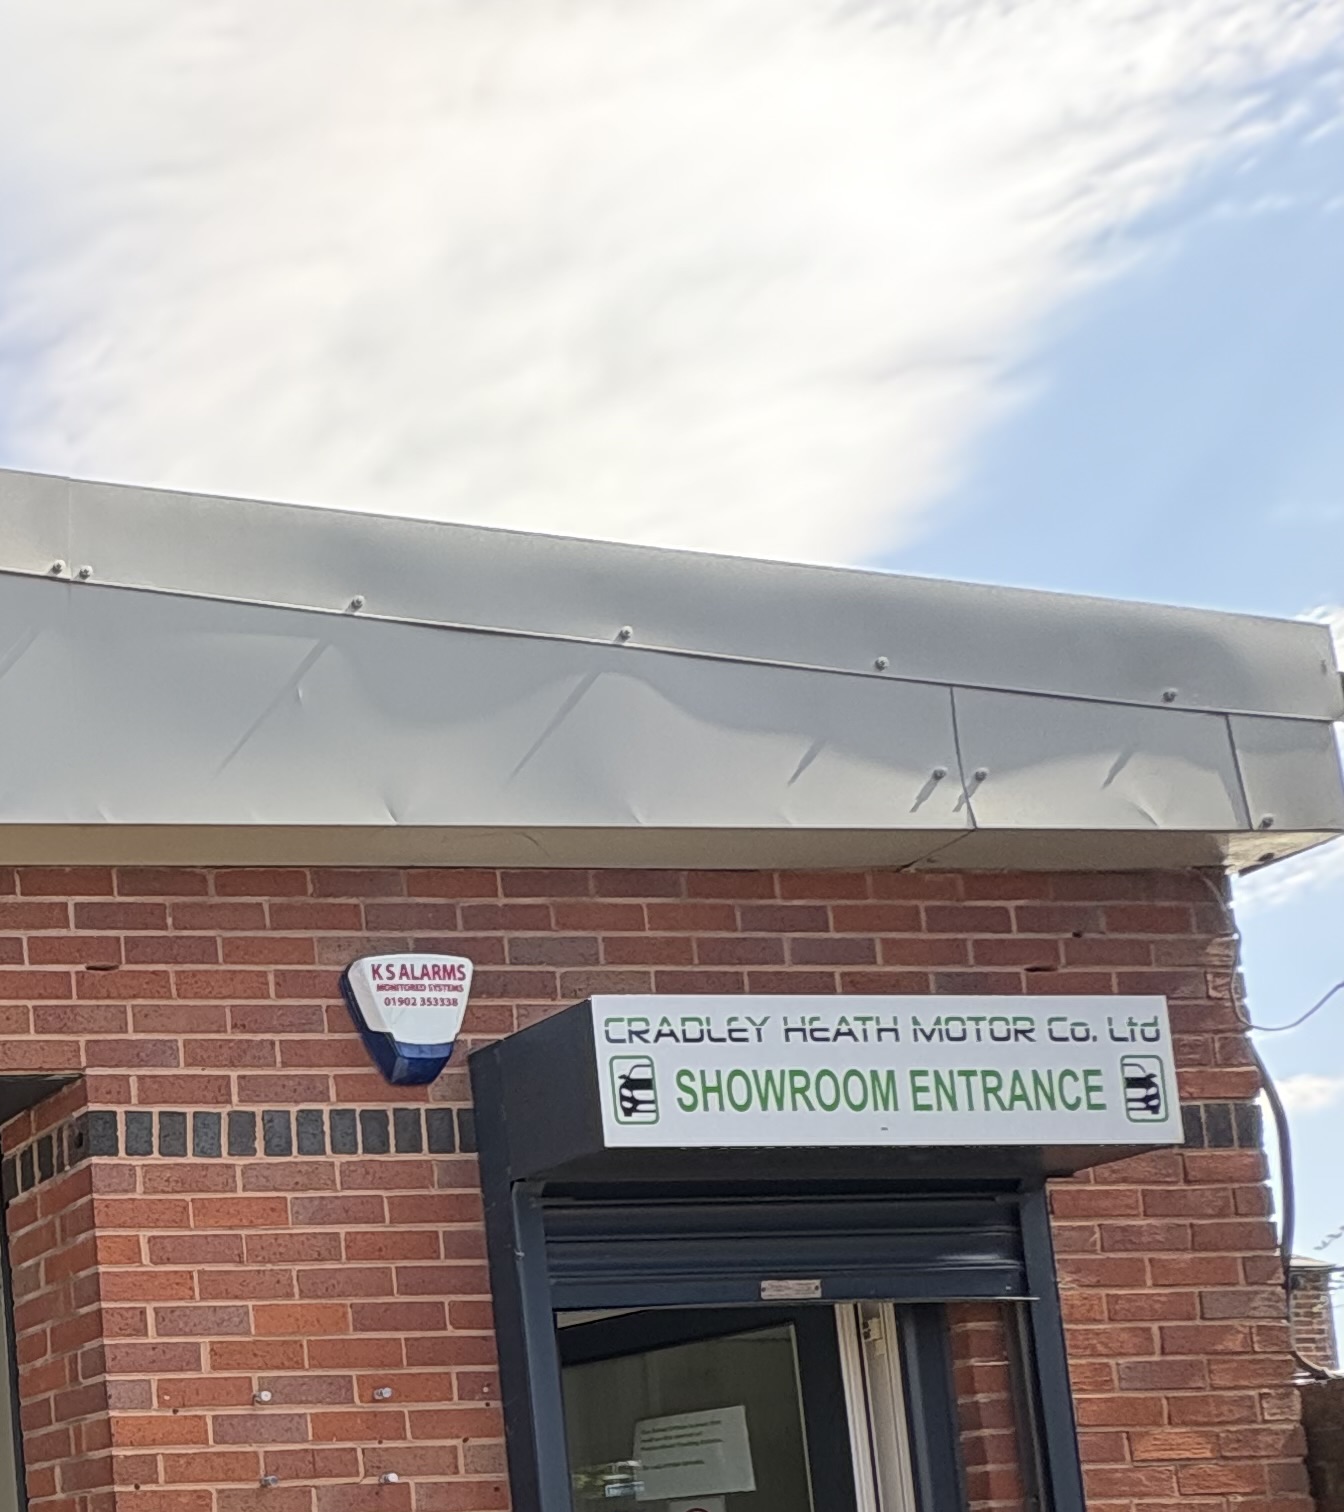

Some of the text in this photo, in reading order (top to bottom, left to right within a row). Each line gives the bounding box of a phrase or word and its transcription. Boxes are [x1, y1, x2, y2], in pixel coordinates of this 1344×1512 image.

[371, 963, 466, 981] K S ALARMS
[384, 997, 417, 1007] 01902
[604, 1015, 1162, 1044] CRADLEY HEATH MOTOR Co. Ltd
[675, 1068, 1108, 1113] SHOWROOM ENTRANCE
